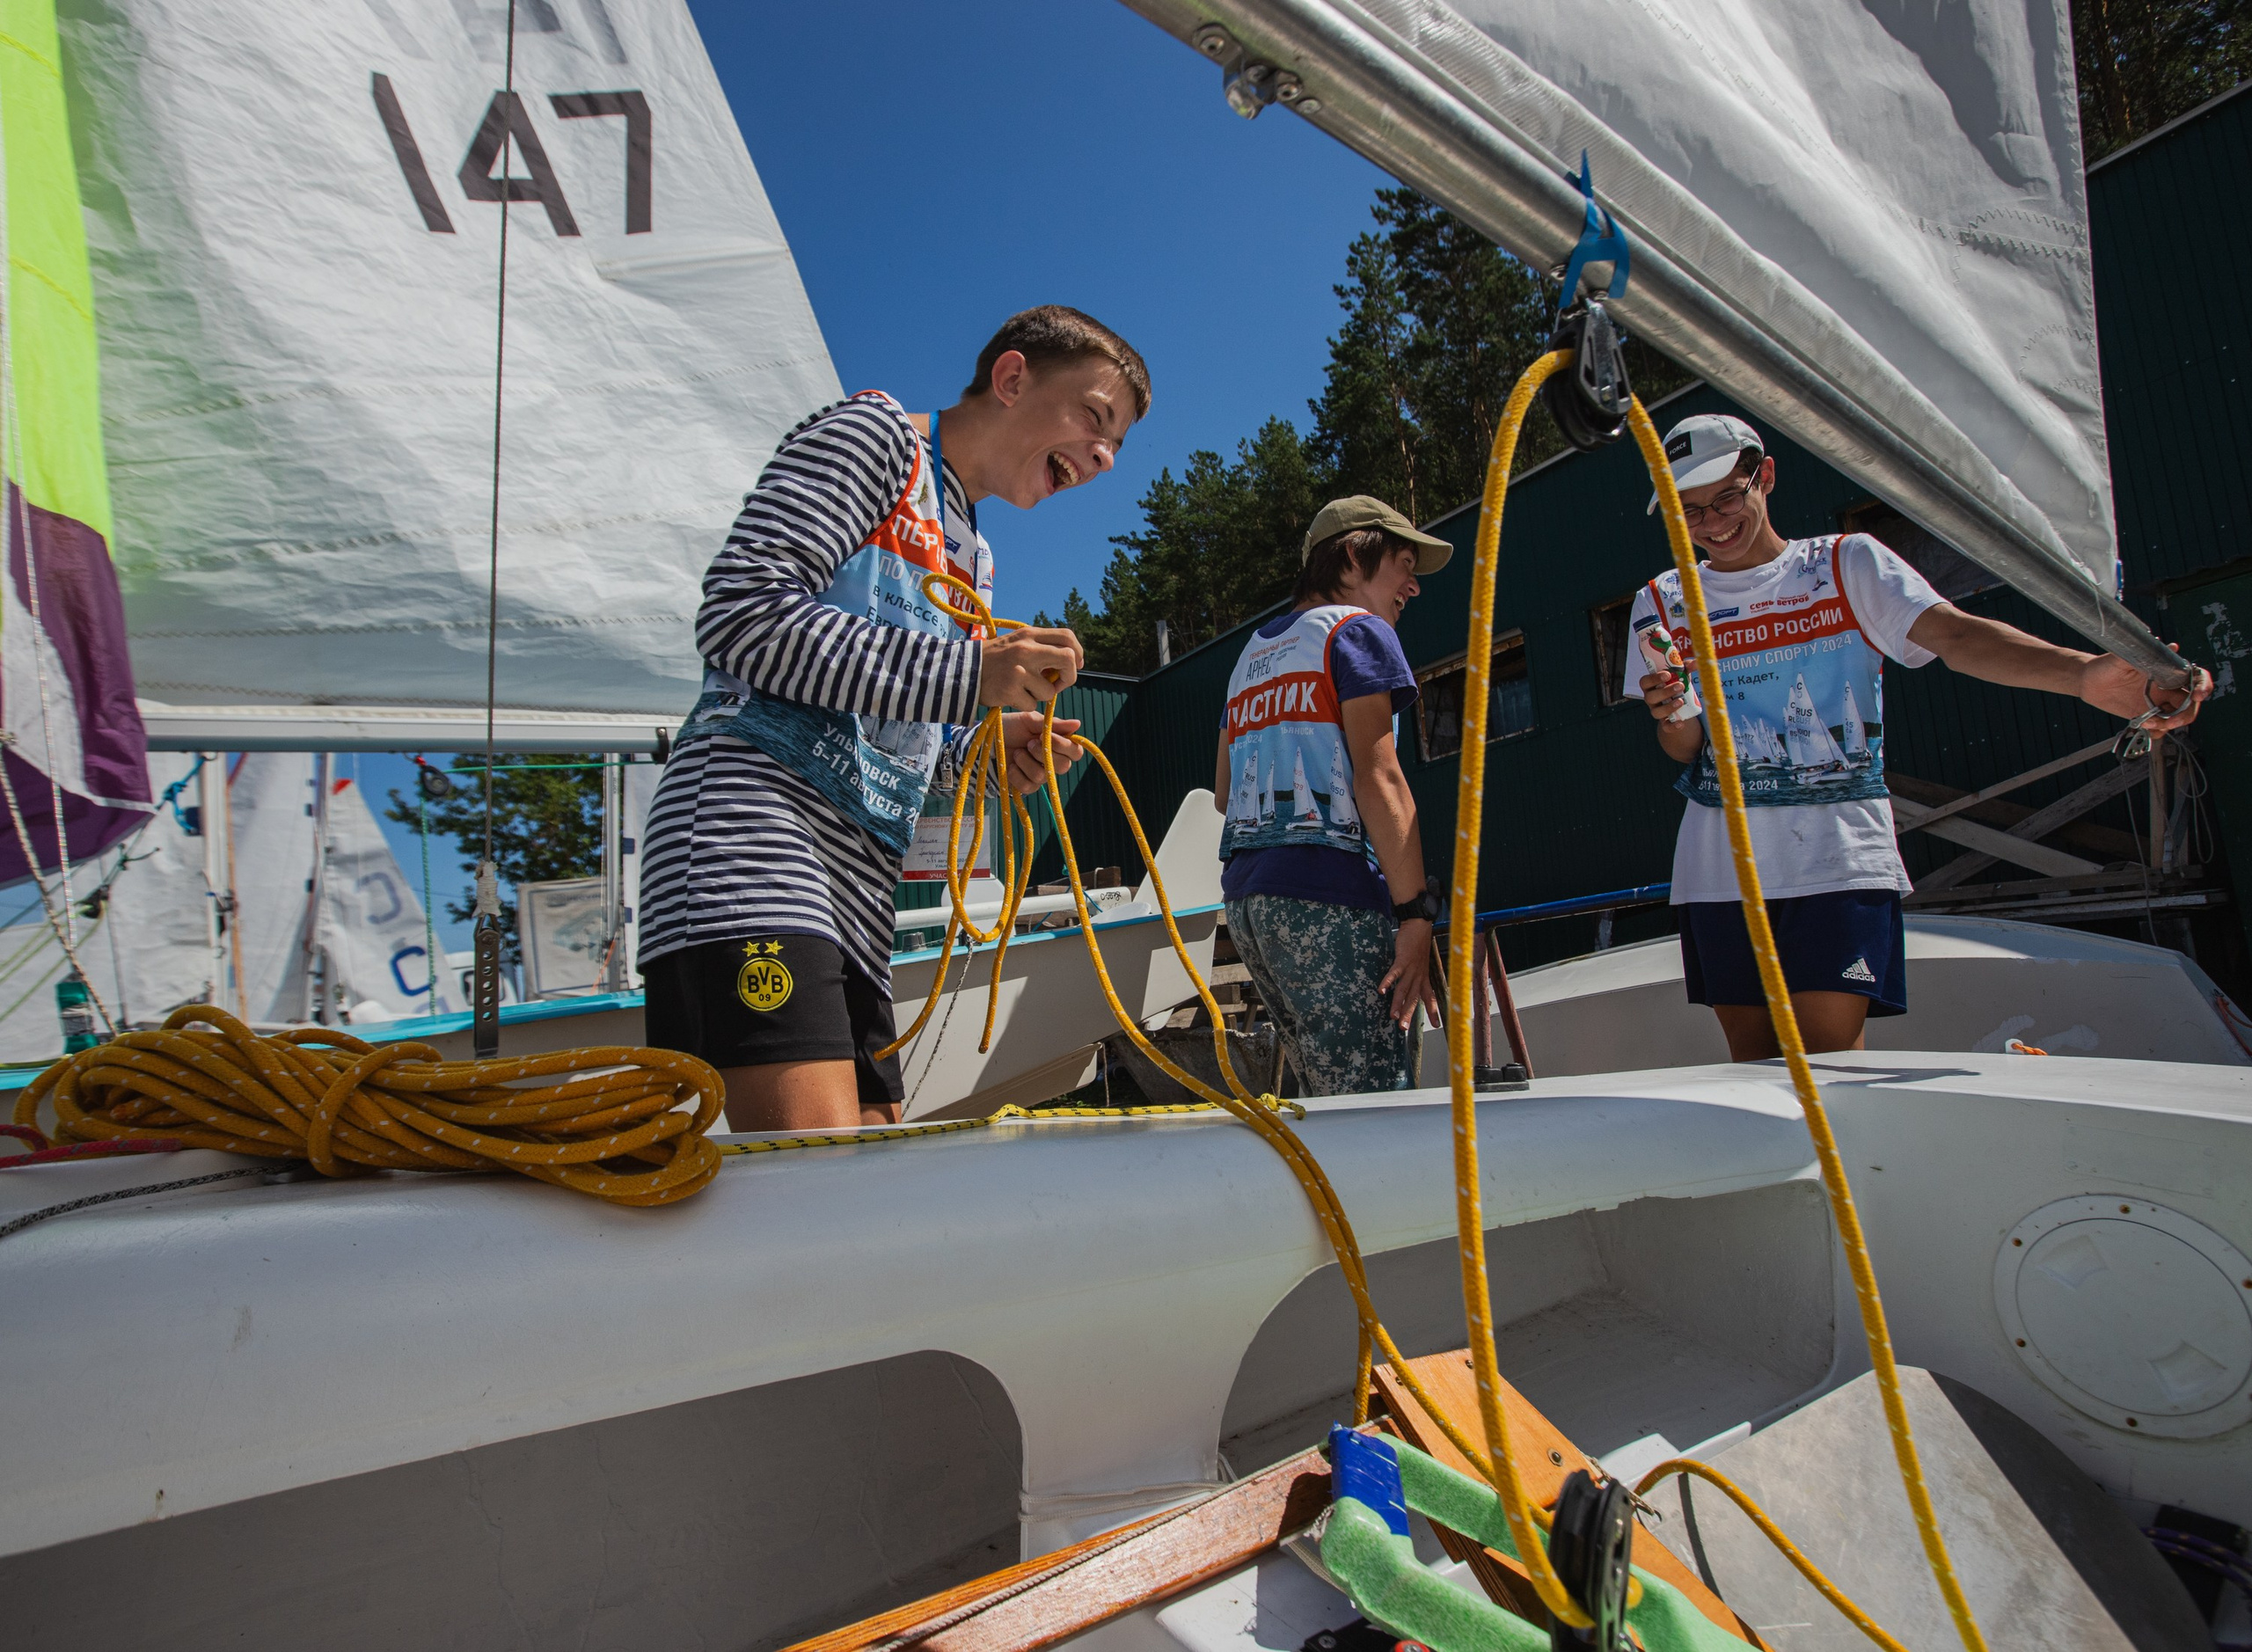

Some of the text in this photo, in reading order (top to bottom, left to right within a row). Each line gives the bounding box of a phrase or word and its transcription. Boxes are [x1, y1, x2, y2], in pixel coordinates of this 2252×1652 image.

[370, 69, 652, 237] 147
[1669, 442, 1686, 456] FORCE
[879, 555, 904, 581] ПО
[873, 584, 881, 597] в
[884, 592, 939, 626] классе
[1773, 607, 1844, 637] РОССИИ
[1765, 642, 1817, 664] СПОРТУ
[1821, 633, 1852, 653] 2024
[1737, 672, 1780, 685] Кадет,
[1737, 691, 1745, 700] 8
[1795, 707, 1812, 717] RUS
[812, 740, 851, 776] 5-11
[849, 771, 903, 818] августа
[1749, 779, 1779, 791] 2024
[747, 967, 784, 993] BVB
[1842, 971, 1875, 983] adidas
